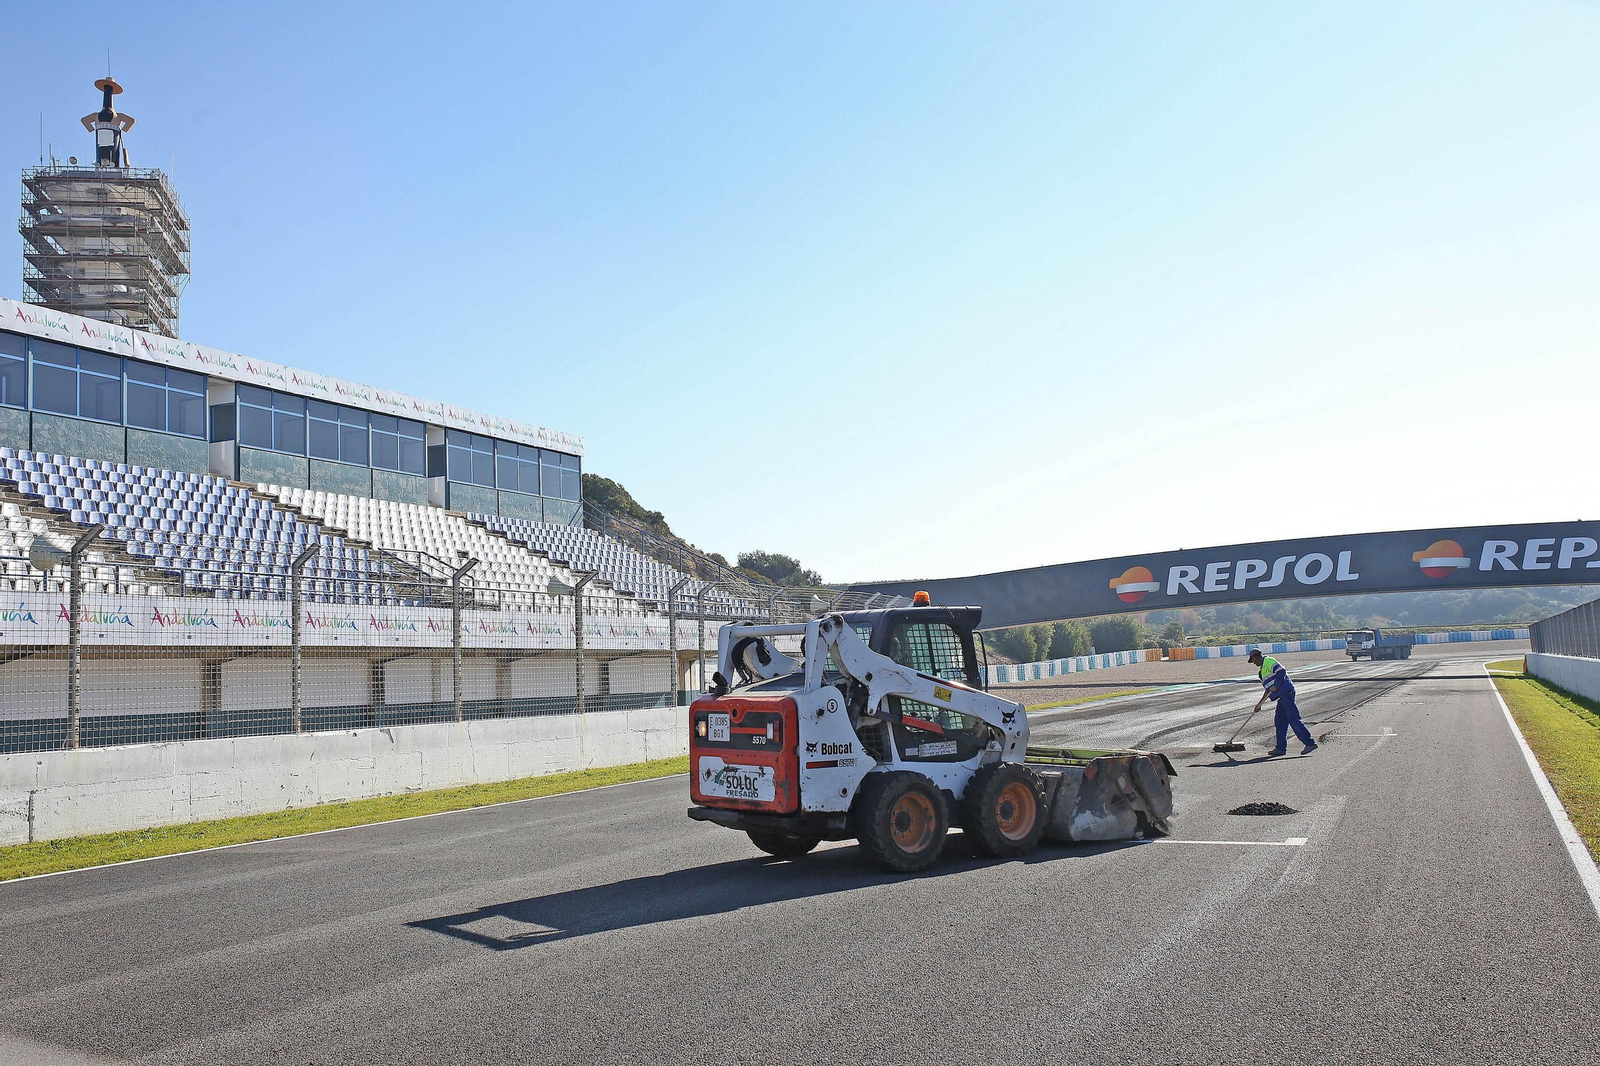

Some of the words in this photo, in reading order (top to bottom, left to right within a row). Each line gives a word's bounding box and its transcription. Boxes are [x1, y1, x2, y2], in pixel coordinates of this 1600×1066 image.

[15, 306, 71, 333] Andalucía
[81, 322, 131, 347] Andalucía
[141, 336, 187, 359] Andalucía
[195, 349, 239, 372] Andalucía
[246, 361, 286, 382] Andalucía
[292, 372, 329, 393] Andalucía
[335, 382, 370, 401] Andalucía
[1166, 550, 1360, 596] REPSOL
[56, 602, 135, 628] Adalucía
[150, 606, 219, 629] Andalucía
[233, 608, 292, 629] Andalucía
[304, 610, 359, 630] Andalucía
[369, 613, 418, 632] Andalucía
[829, 702, 835, 711] 5
[710, 716, 713, 726] E
[714, 717, 728, 726] 0385
[713, 729, 724, 738] BGX
[752, 736, 767, 745] S570
[821, 742, 852, 755] Bobcat
[838, 758, 855, 768] S570
[725, 789, 759, 798] FRESADO
